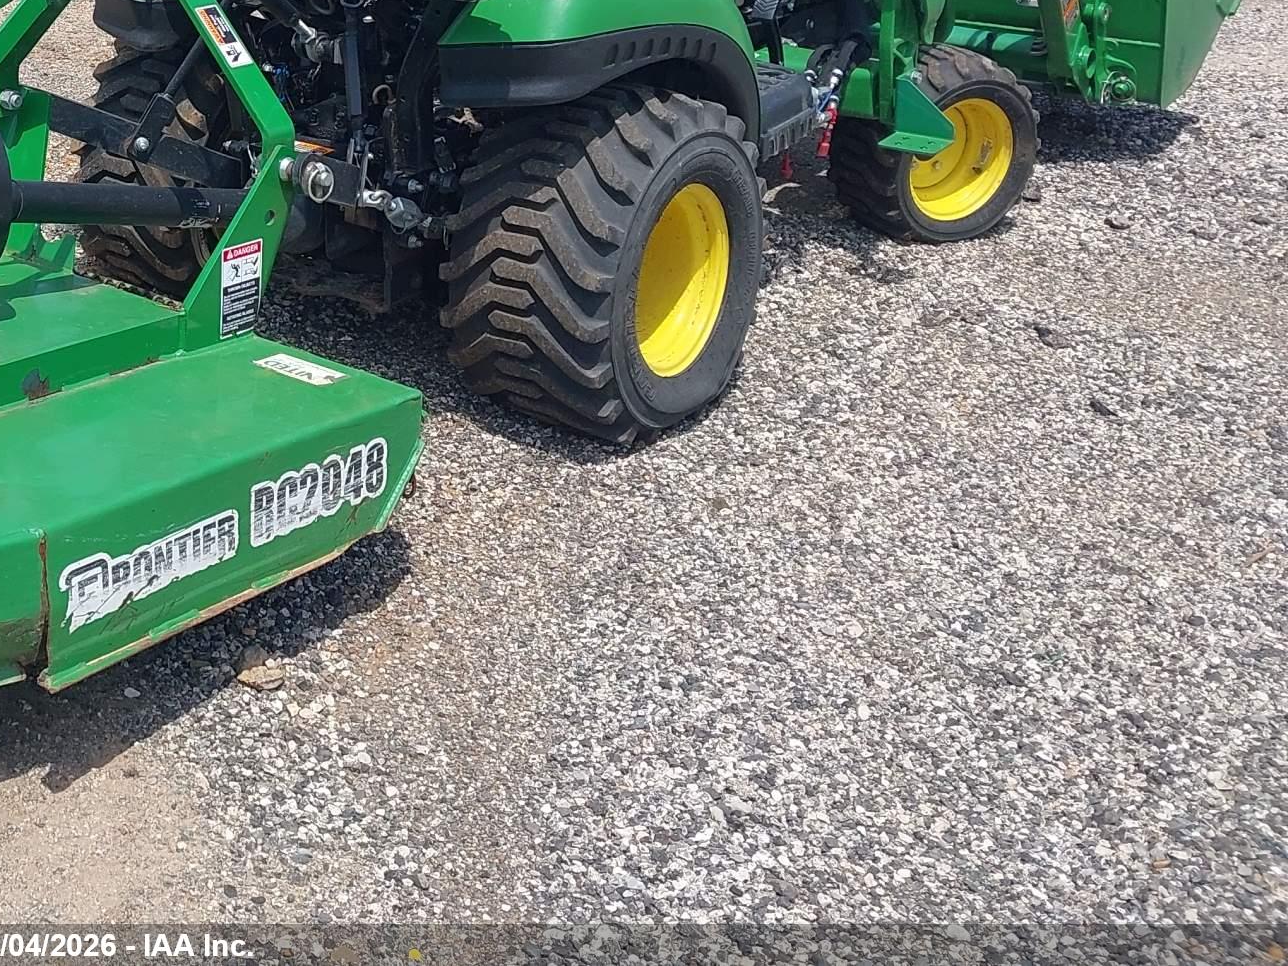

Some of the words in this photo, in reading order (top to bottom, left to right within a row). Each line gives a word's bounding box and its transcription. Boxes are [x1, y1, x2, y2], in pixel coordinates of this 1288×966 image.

[233, 243, 259, 257] DANGER
[62, 511, 238, 622] FRONTIER
[252, 439, 387, 544] RC2048
